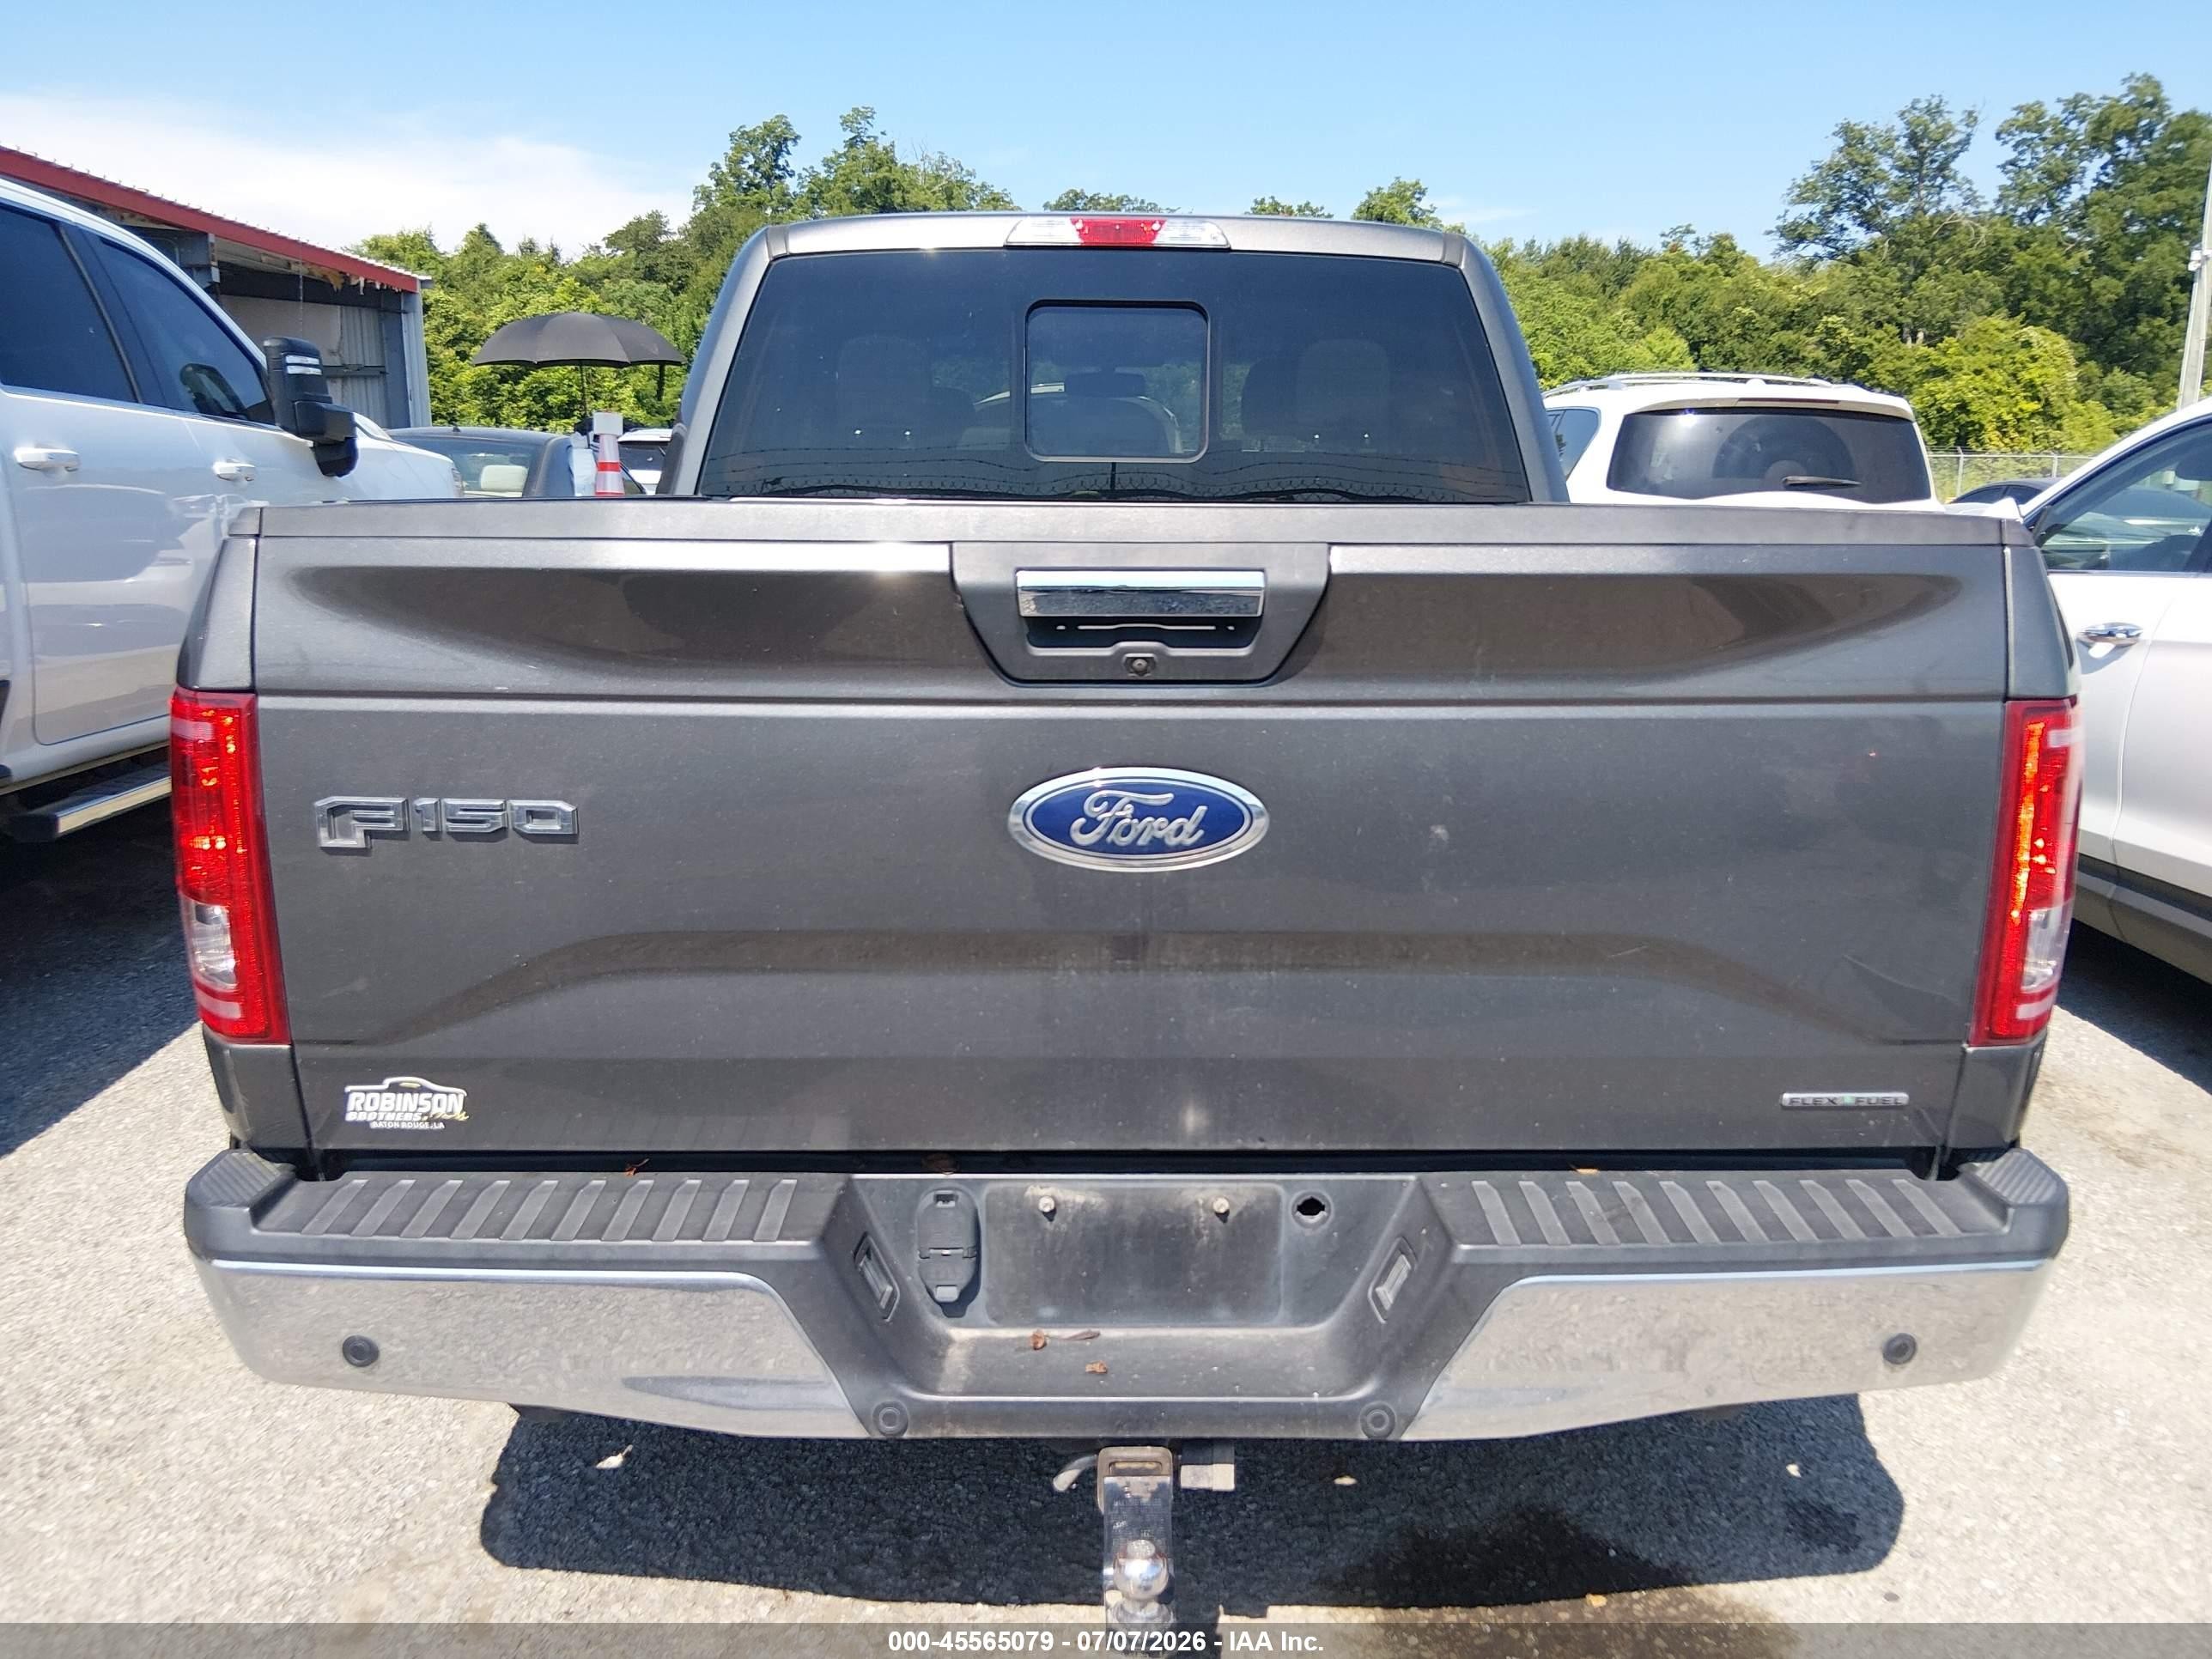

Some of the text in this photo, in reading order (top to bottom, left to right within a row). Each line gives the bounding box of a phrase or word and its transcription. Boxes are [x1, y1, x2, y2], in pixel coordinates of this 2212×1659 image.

[1070, 789, 1207, 847] Ford
[346, 1092, 465, 1112] ROBINSON
[1789, 1096, 1904, 1106] FLEX FUEL
